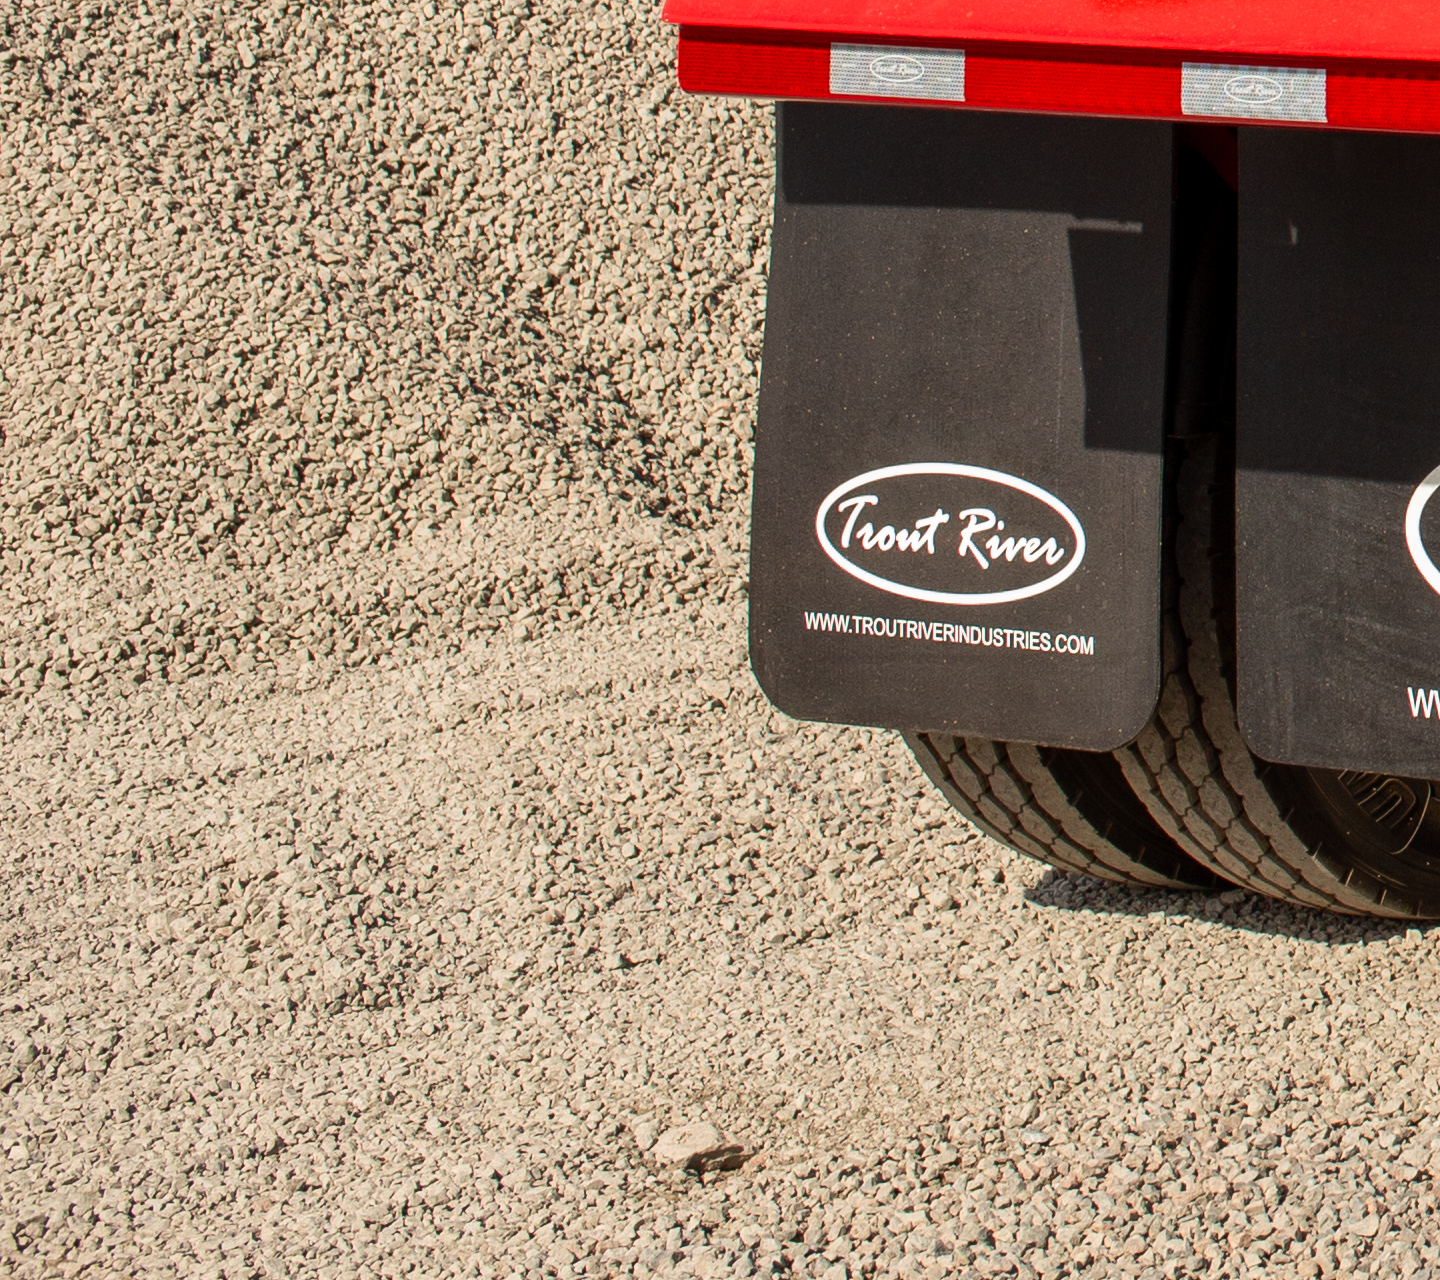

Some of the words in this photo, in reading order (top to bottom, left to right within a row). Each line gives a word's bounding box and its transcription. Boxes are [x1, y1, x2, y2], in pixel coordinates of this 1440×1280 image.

[837, 495, 949, 554] Trout
[958, 508, 1065, 569] River
[804, 611, 1094, 655] WWW.TROUTRIVERINDUSTRIES.COM
